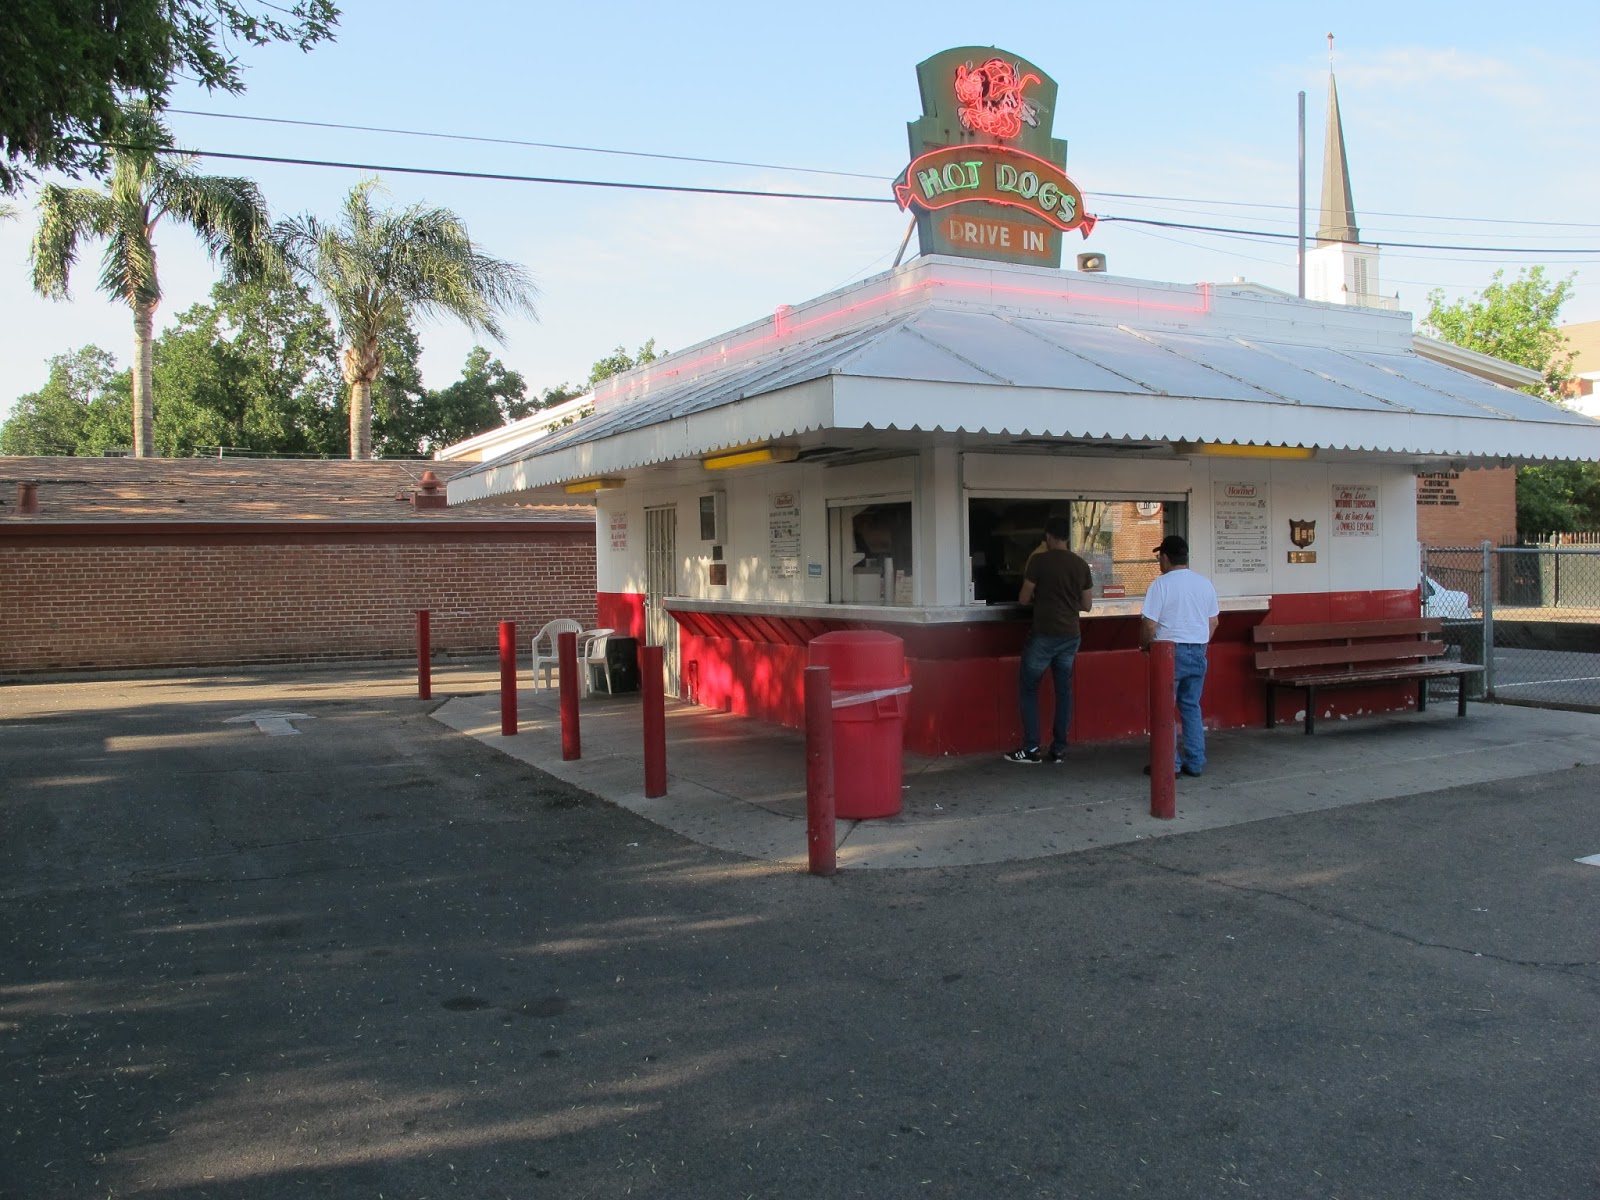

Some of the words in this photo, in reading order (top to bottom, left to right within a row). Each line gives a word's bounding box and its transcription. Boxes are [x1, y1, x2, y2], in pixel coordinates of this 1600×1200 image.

[917, 161, 983, 200] HOT
[995, 163, 1076, 223] DOGS
[950, 219, 1010, 247] DRIVE
[1023, 230, 1044, 252] IN
[1228, 486, 1255, 495] Hormel
[1335, 500, 1352, 508] WITHOUT
[1353, 500, 1375, 508] PERMISSION
